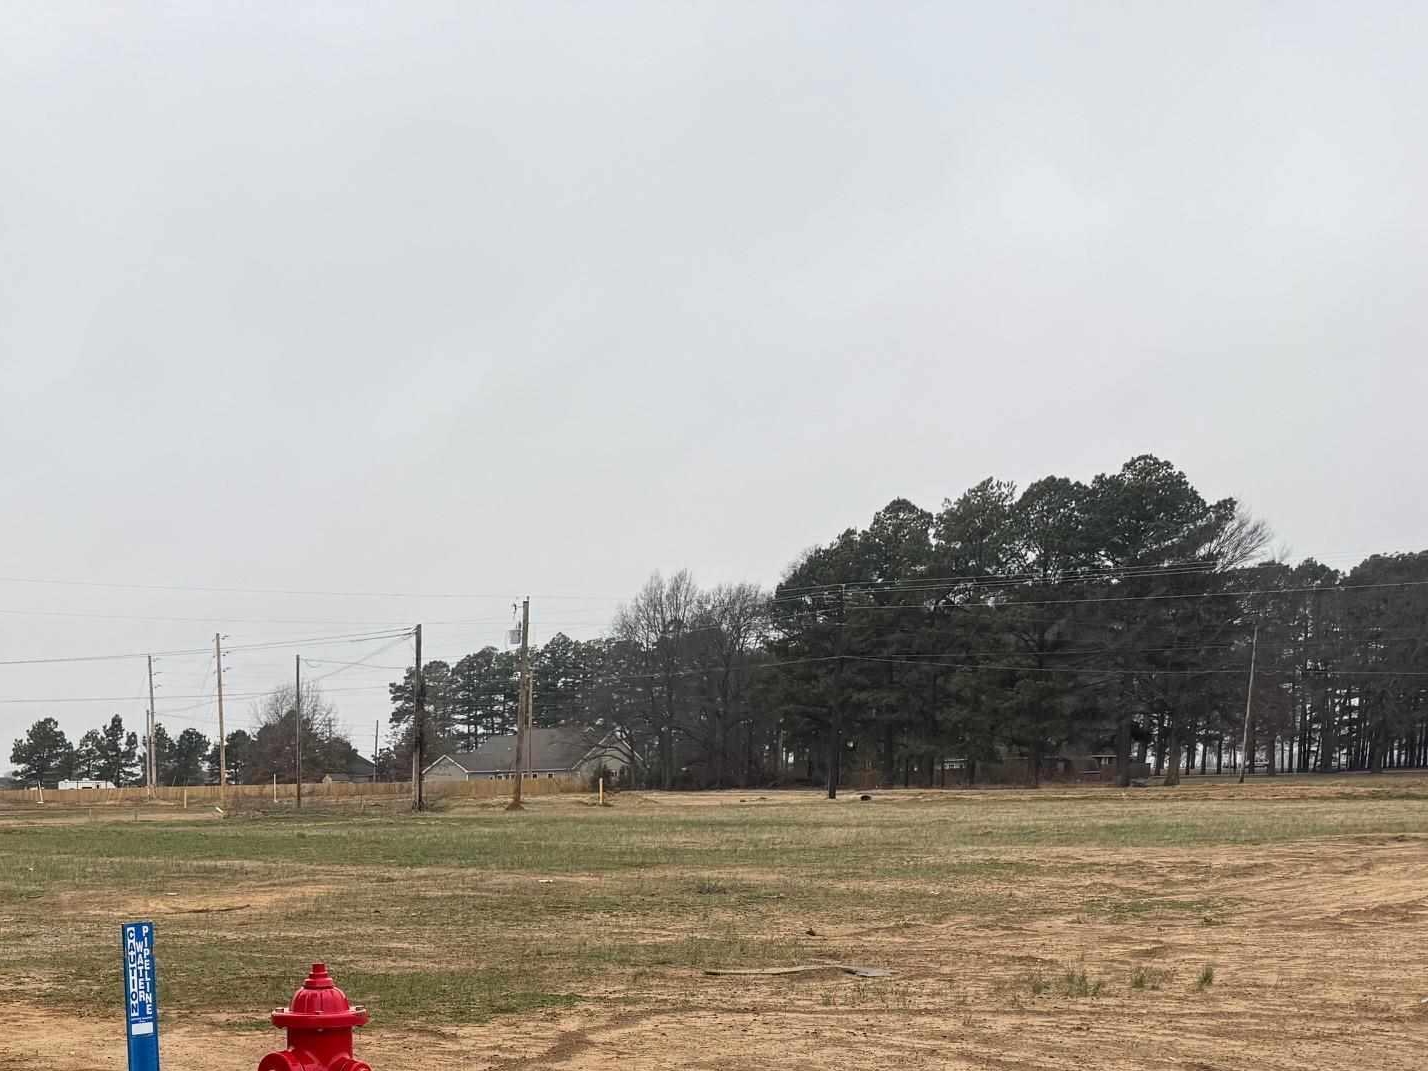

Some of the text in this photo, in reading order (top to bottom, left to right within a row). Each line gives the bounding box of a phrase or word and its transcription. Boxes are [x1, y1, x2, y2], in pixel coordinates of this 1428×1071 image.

[127, 929, 139, 1015] CAUTION
[135, 941, 146, 1002] WATER
[142, 926, 152, 1015] PIPELINE
